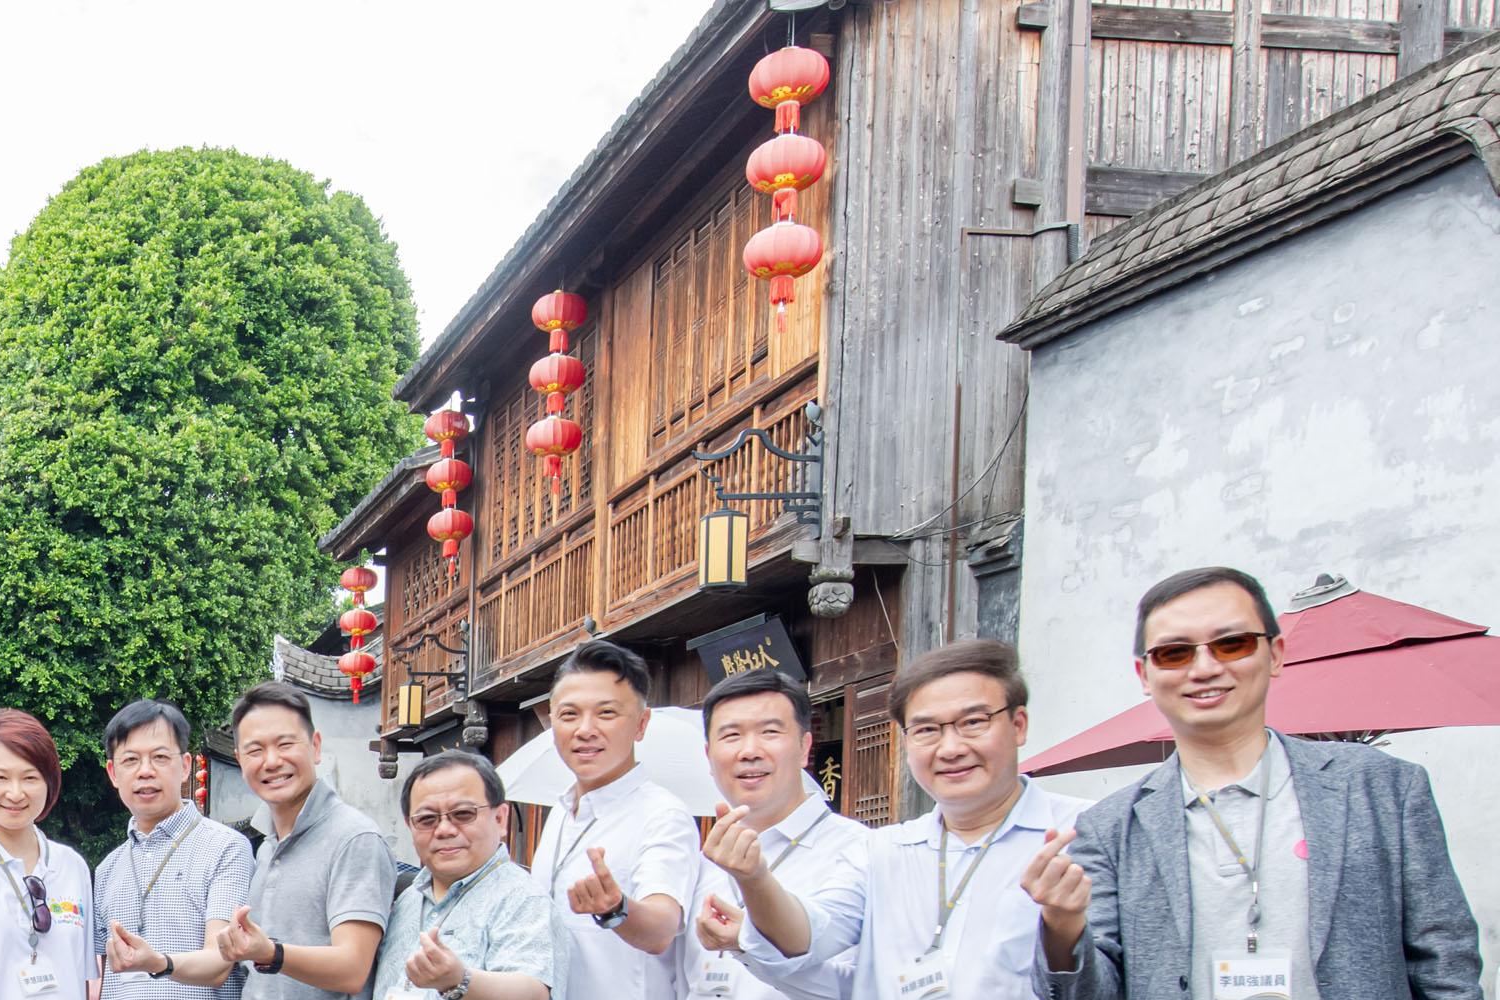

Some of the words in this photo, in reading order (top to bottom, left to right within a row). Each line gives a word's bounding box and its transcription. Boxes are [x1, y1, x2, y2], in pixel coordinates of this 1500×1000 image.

[1219, 974, 1286, 987] 李鎮強議員
